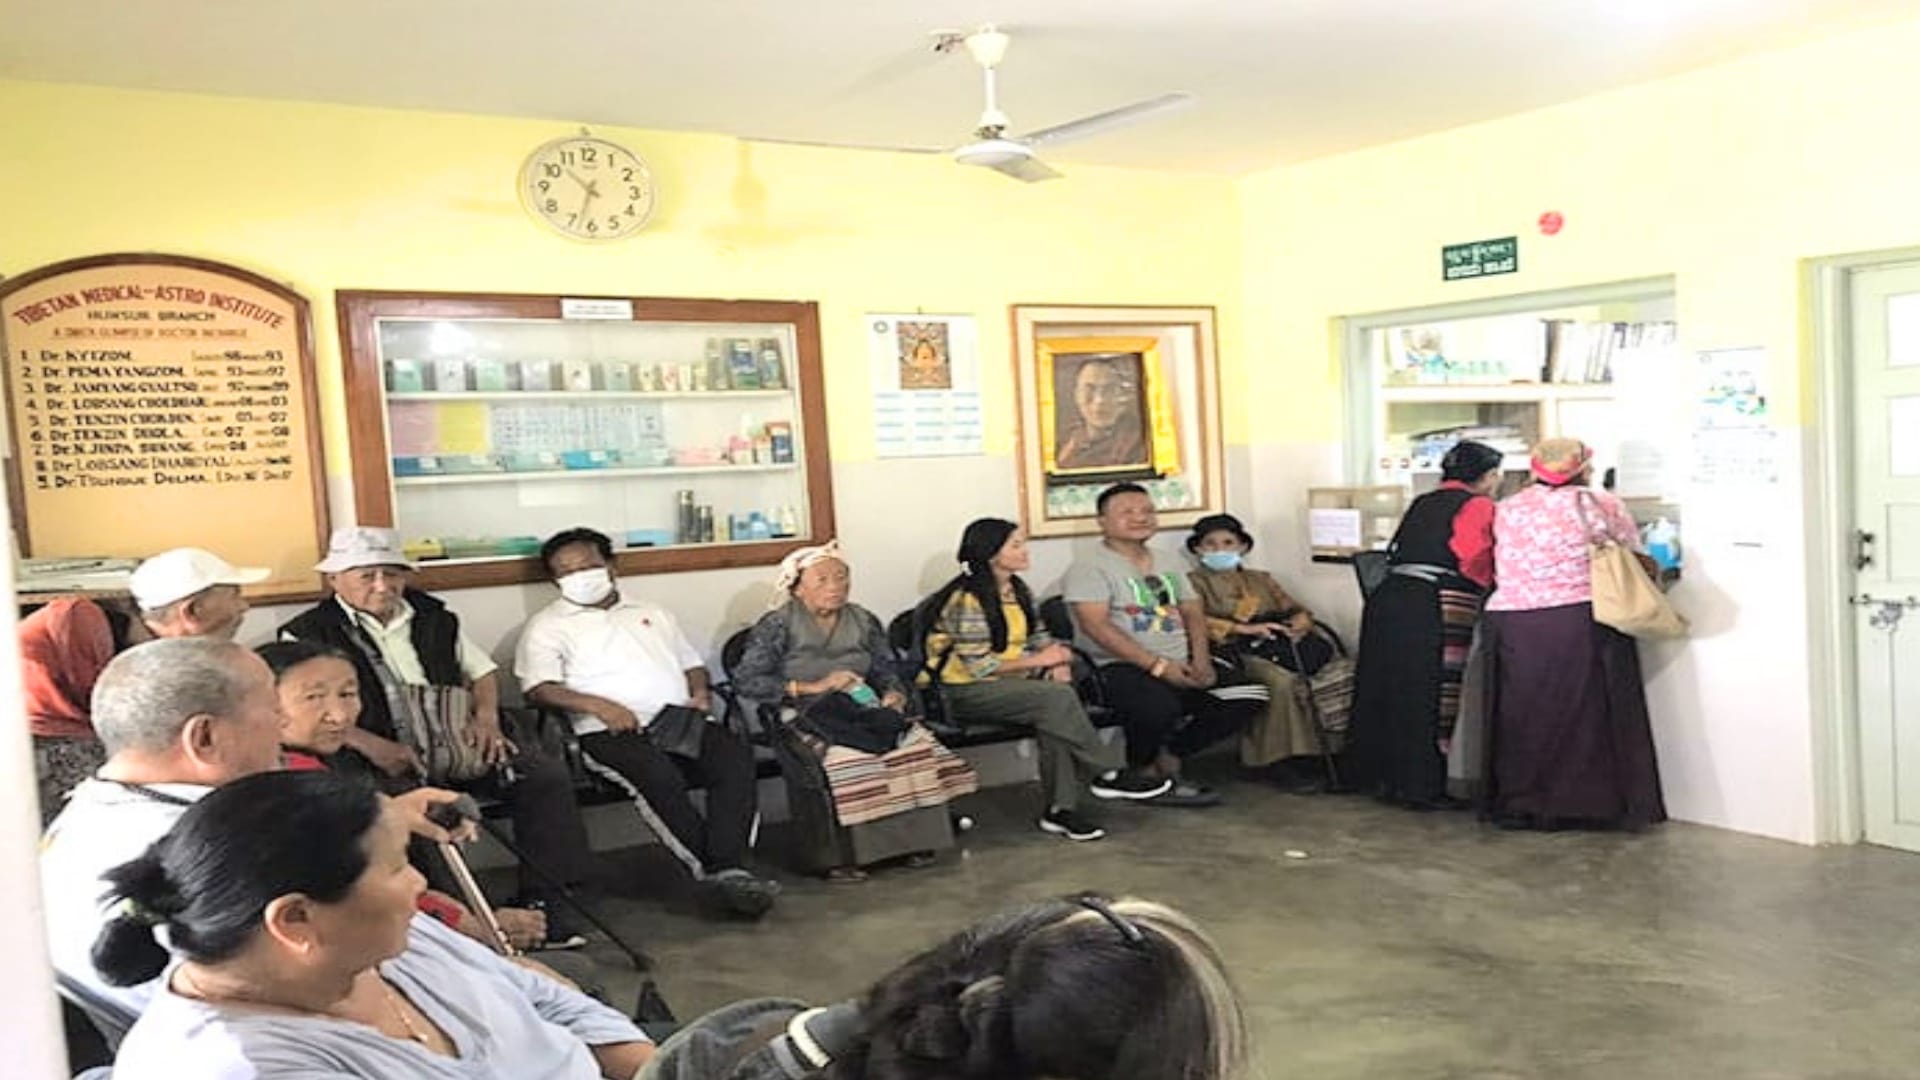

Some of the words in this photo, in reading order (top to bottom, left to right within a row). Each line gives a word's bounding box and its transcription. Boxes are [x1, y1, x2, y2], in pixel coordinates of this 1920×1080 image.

[560, 151, 575, 166] 11
[580, 147, 597, 162] 12
[608, 153, 614, 168] 1
[543, 163, 561, 178] 10
[621, 168, 634, 182] 2
[537, 180, 550, 193] 9
[629, 186, 641, 200] 3
[545, 199, 558, 213] 8
[624, 204, 635, 216] 4
[566, 213, 577, 227] 7
[586, 219, 598, 232] 6
[608, 216, 619, 229] 5
[13, 294, 81, 326] TIBETAN
[208, 293, 285, 329] INSTITUTE
[157, 310, 217, 322] BRANCH
[68, 366, 112, 378] PEMA
